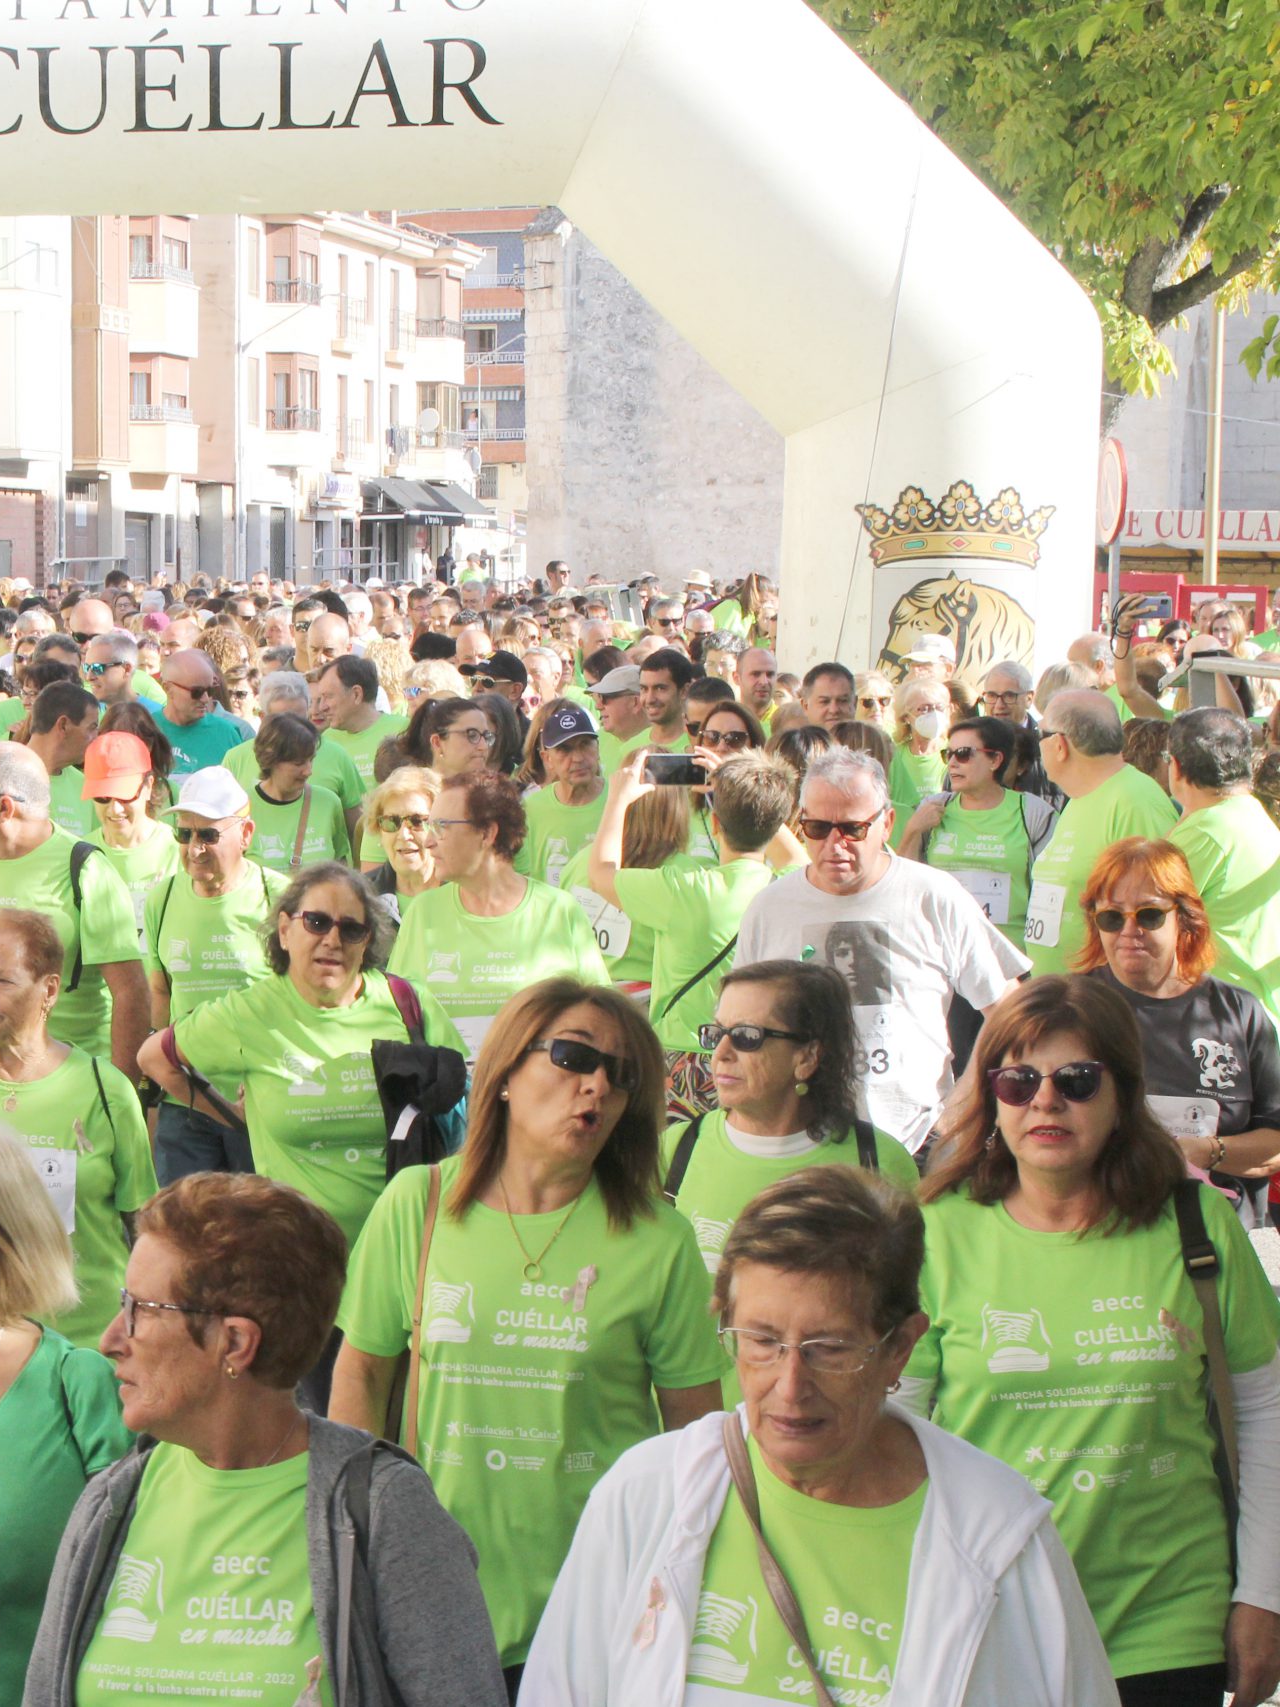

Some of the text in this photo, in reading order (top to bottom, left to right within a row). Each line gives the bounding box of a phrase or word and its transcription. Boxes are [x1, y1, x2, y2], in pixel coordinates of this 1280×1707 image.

[1122, 510, 1280, 542] E CULLA
[1024, 917, 1044, 940] 80
[487, 951, 516, 959] aecc
[520, 1282, 570, 1299] aecc
[1091, 1296, 1145, 1313] aecc
[496, 1308, 588, 1334] CUÉLLAR
[490, 1333, 590, 1353] en marcha
[1074, 1323, 1173, 1347] CUÉLLAR
[1072, 1342, 1177, 1368] en marcha
[462, 1364, 512, 1376] SOLIDARIA
[514, 1367, 558, 1379] CUÉLLAR
[999, 1390, 1044, 1402] MARCHA
[1045, 1386, 1101, 1398] SOLIDARIA
[1104, 1382, 1152, 1394] CUÉLLAR
[463, 1424, 514, 1437] Fundación
[1049, 1446, 1104, 1459] Fundación
[212, 1555, 271, 1575] aecc
[186, 1591, 295, 1622] CUÉLLAR
[823, 1606, 893, 1641] aecc
[179, 1623, 296, 1647] en marcha
[90, 1662, 130, 1676] MARCHA
[134, 1667, 195, 1681] SOLIDARIA
[199, 1669, 254, 1683] CUÉLLAR
[265, 1672, 296, 1686] 2022
[97, 1679, 263, 1699] A favor de la lucha contra el cáncer
[775, 1676, 813, 1697] en
